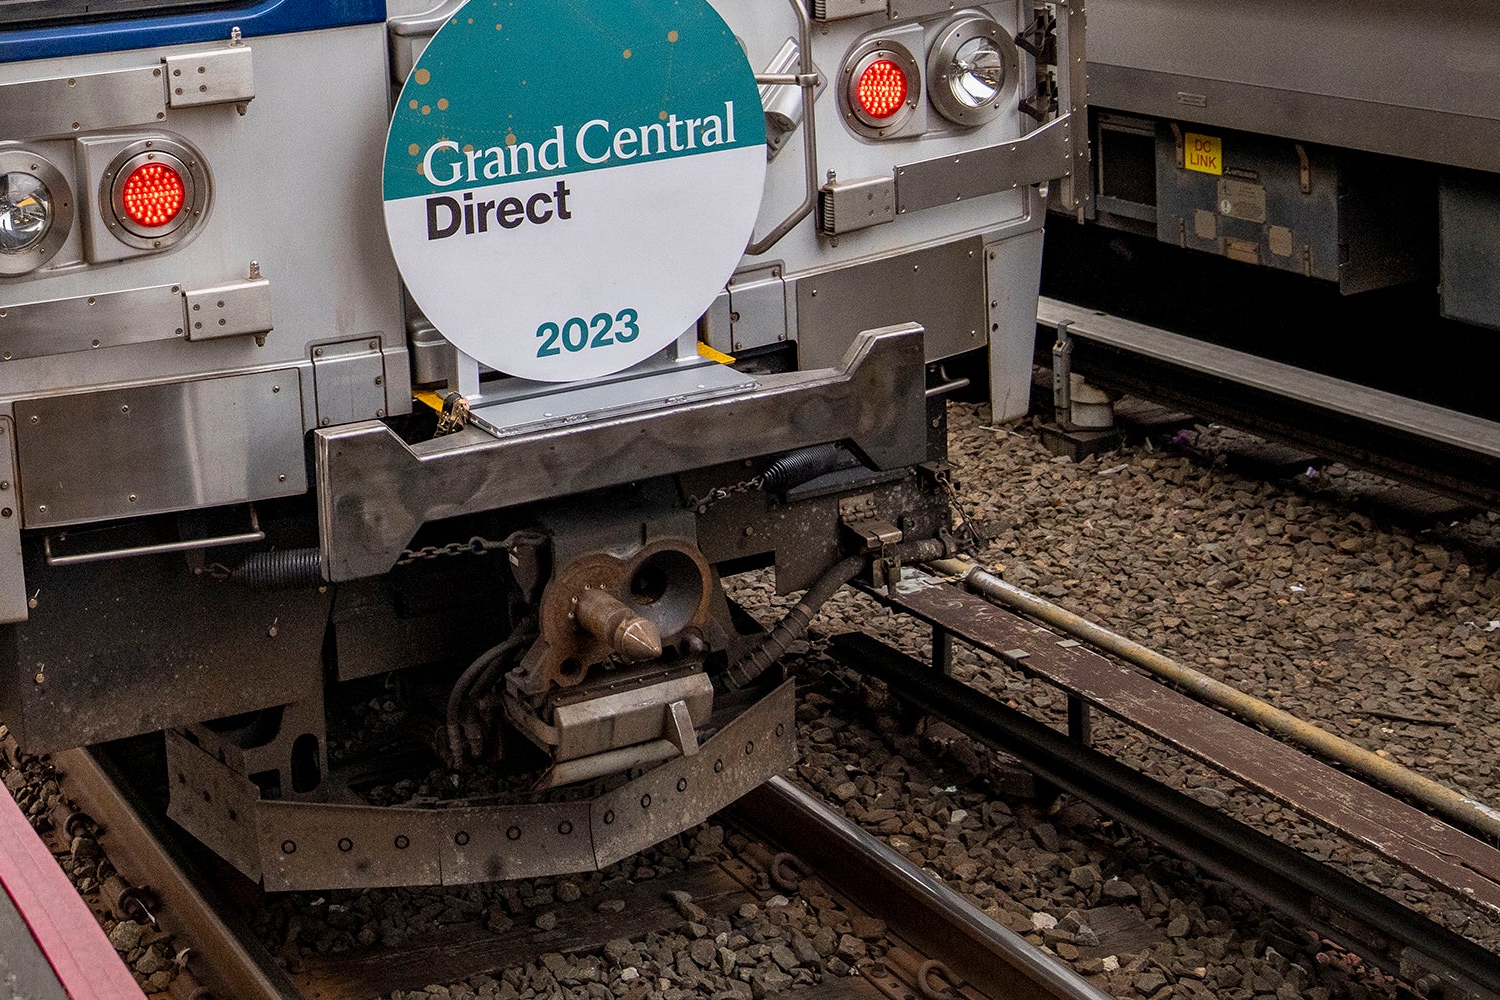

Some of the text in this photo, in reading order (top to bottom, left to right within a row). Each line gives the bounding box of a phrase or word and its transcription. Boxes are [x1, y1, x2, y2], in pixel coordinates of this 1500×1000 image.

[423, 100, 737, 186] Grand Central
[1190, 152, 1217, 169] LINK
[1194, 138, 1212, 153] DC
[425, 180, 572, 241] Direct
[536, 308, 640, 358] 2023
